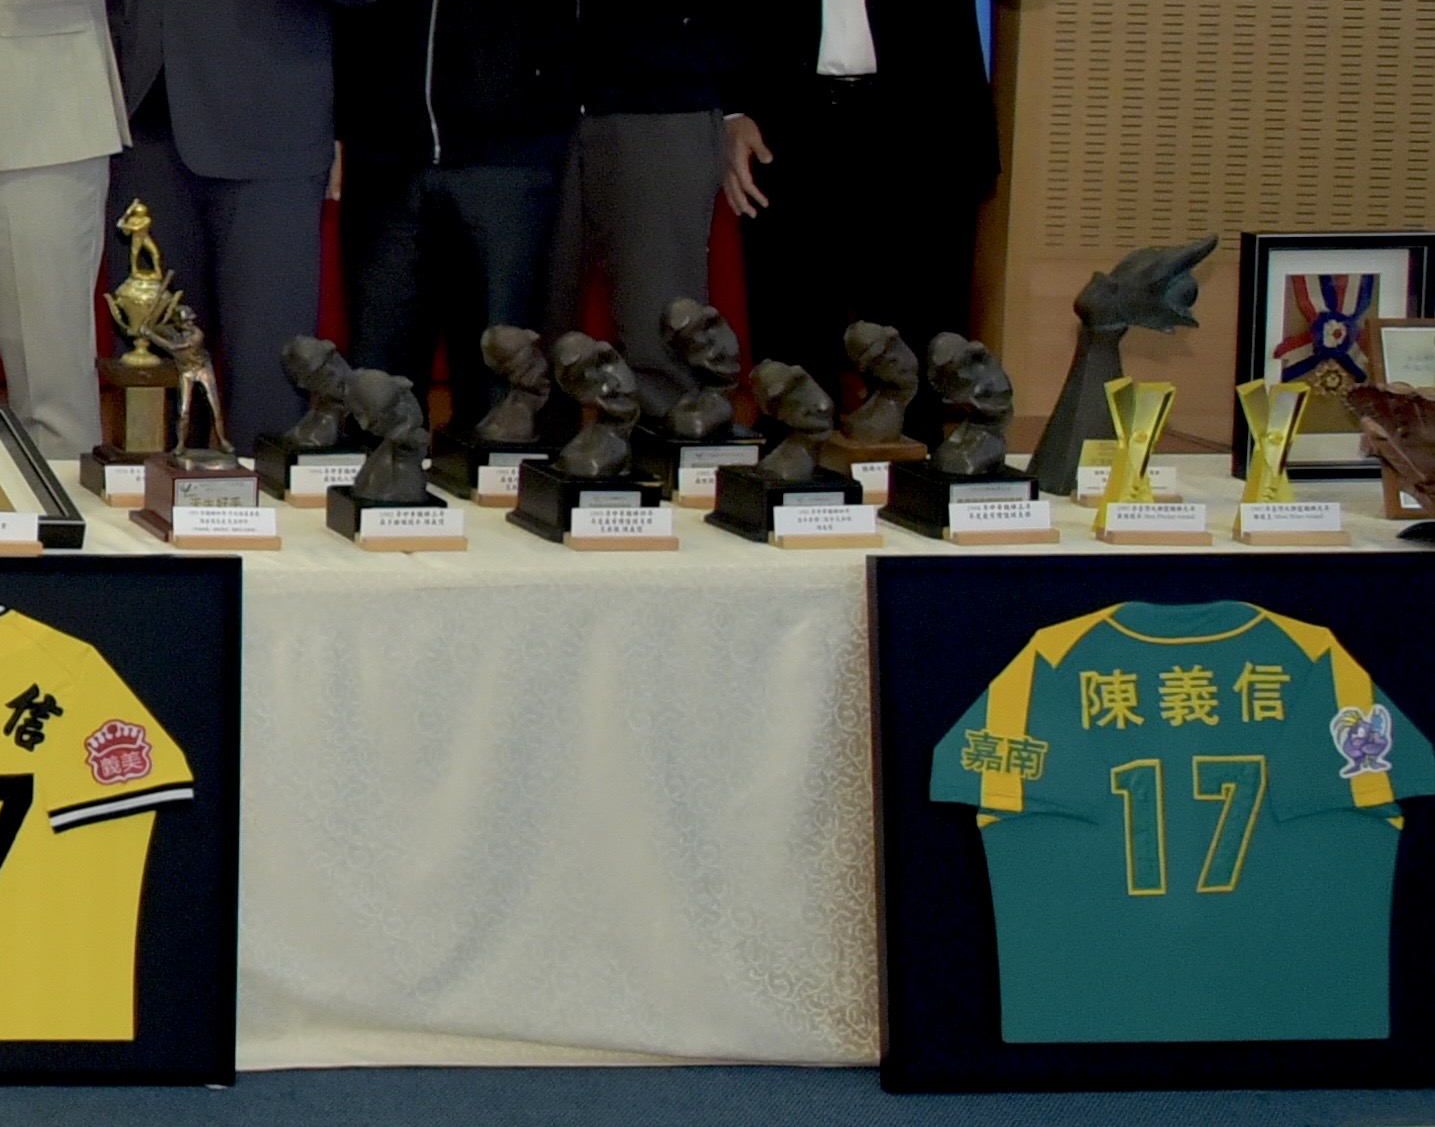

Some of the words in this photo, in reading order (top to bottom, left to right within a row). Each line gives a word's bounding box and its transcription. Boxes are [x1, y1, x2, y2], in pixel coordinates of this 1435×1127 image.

[1080, 662, 1291, 729] 陳義信
[960, 727, 1050, 781] 嘉南
[1110, 754, 1268, 896] 17
